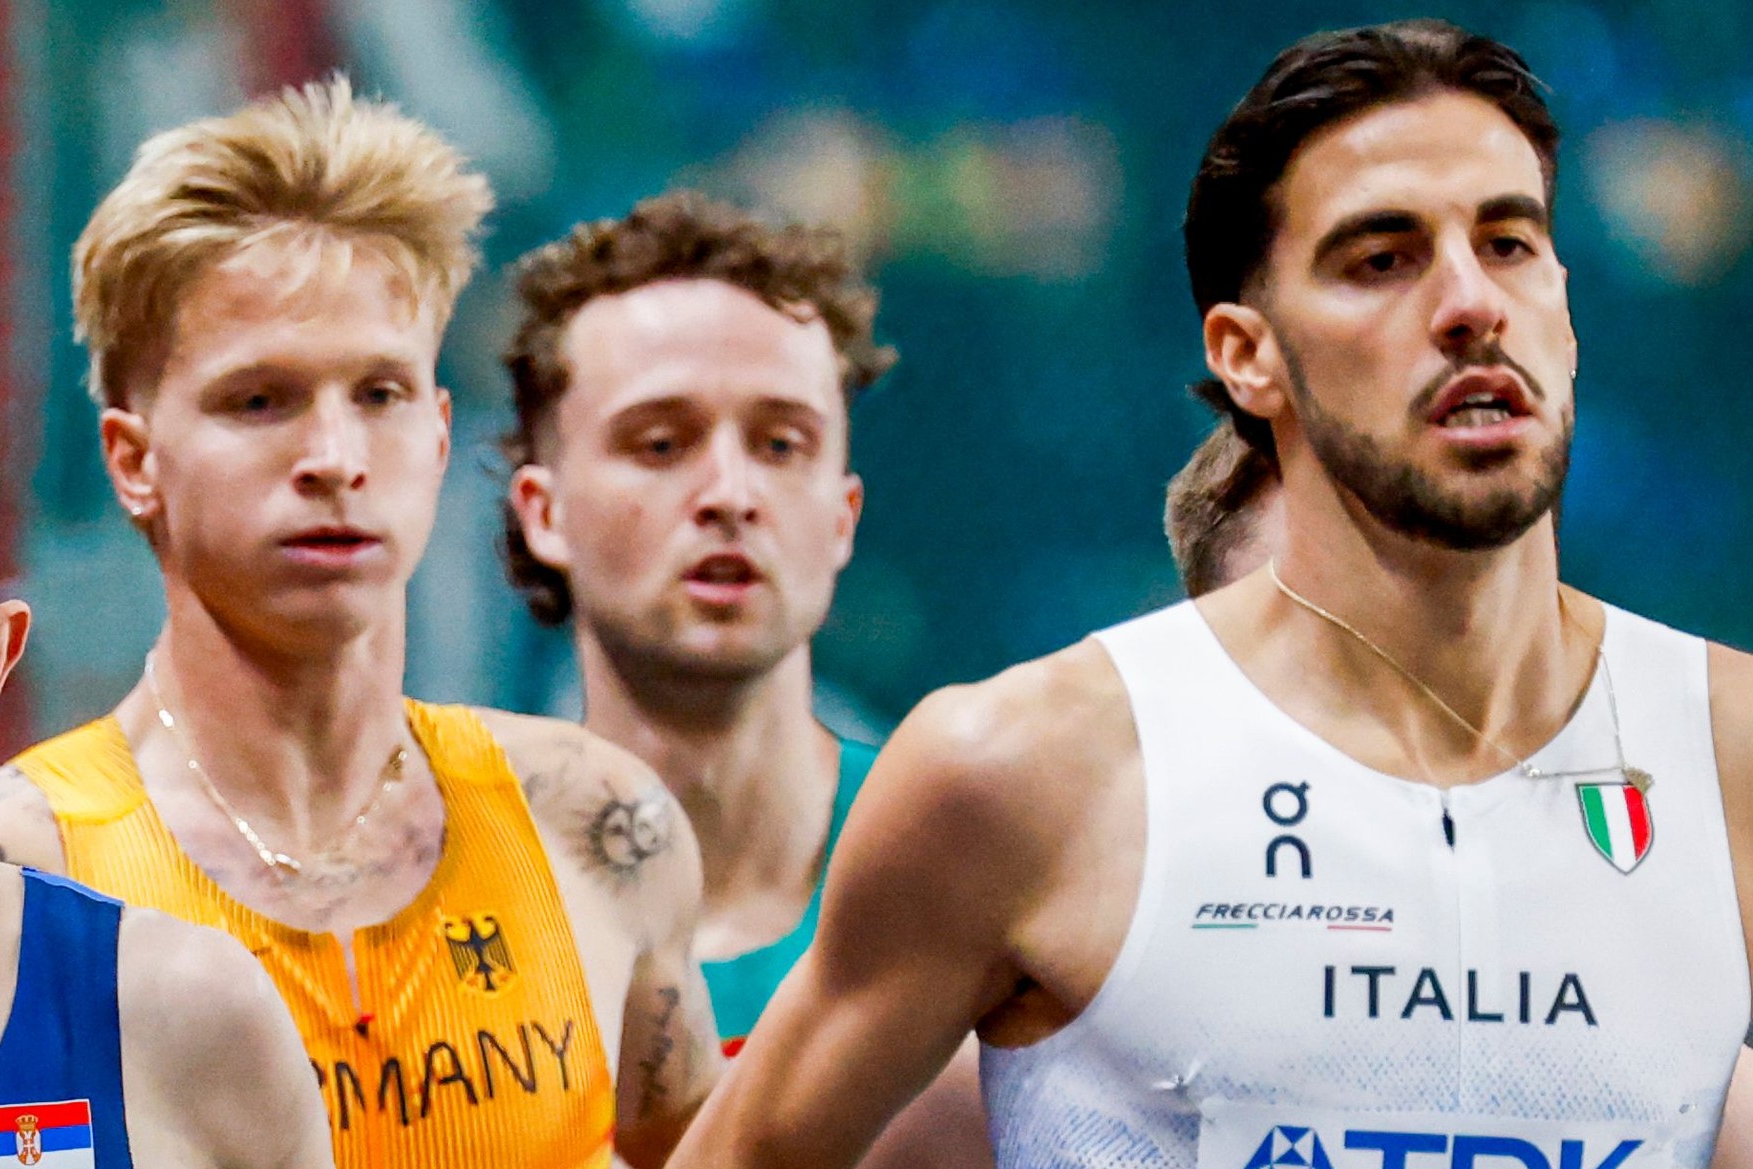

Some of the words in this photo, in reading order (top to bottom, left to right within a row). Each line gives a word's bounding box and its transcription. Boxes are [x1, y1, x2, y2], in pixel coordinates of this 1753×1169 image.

[1195, 903, 1395, 922] FRECCIAROSSA
[1322, 965, 1600, 1027] ITALIA
[301, 1019, 573, 1130] MANY
